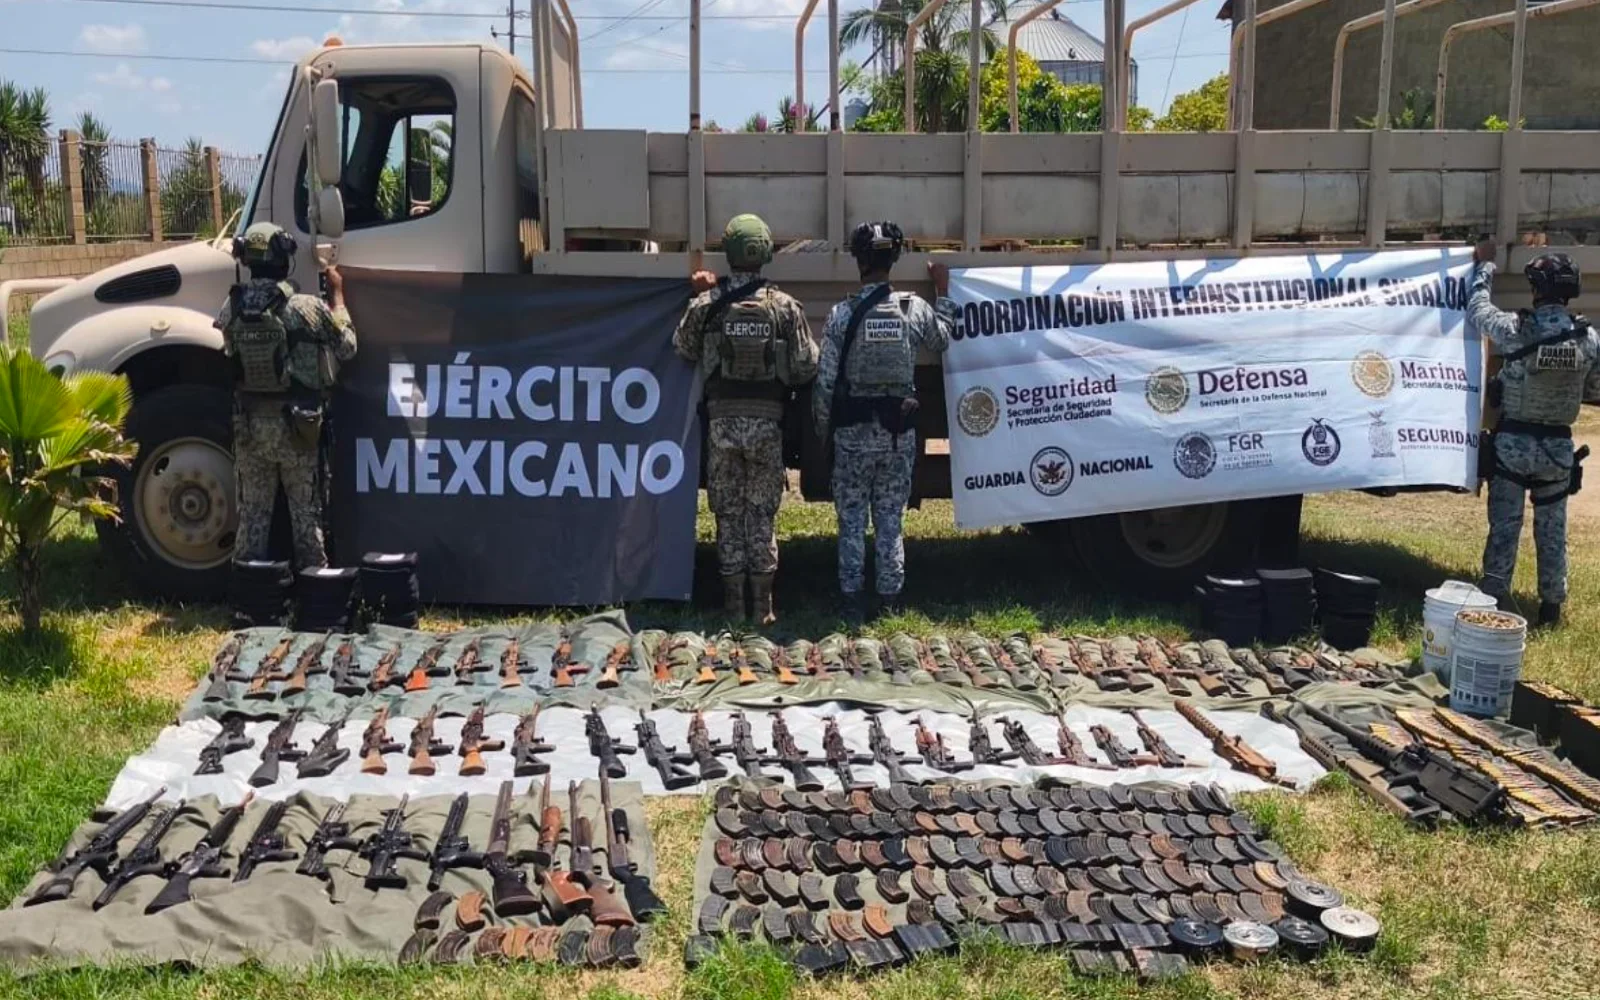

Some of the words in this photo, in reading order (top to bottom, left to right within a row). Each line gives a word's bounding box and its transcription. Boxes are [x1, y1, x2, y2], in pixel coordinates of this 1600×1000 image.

[951, 286, 1126, 341] COORDINACIÓN
[1378, 277, 1468, 311] SINALOA
[866, 320, 900, 330] GUARDIA
[868, 330, 900, 339] NACIONAL
[1198, 367, 1308, 395] Defensa
[1400, 361, 1467, 381] Marina
[387, 352, 661, 424] EJÉRCITO
[1005, 374, 1117, 407] Seguridad
[1443, 381, 1453, 390] de
[1052, 403, 1064, 412] de
[1066, 398, 1112, 412] Seguridad
[1241, 396, 1250, 404] de
[1252, 395, 1259, 403] la
[1261, 392, 1292, 402] Defensa
[1294, 389, 1327, 399] Nacional
[1007, 420, 1013, 429] y
[1015, 413, 1062, 428] Protección
[1064, 408, 1112, 422] Ciudadana
[1228, 433, 1264, 452] FGR
[1397, 428, 1478, 448] SEGURIDAD
[356, 438, 685, 498] MEXICANO
[964, 470, 1026, 490] GUARDIA
[1080, 456, 1153, 476] NACIONAL
